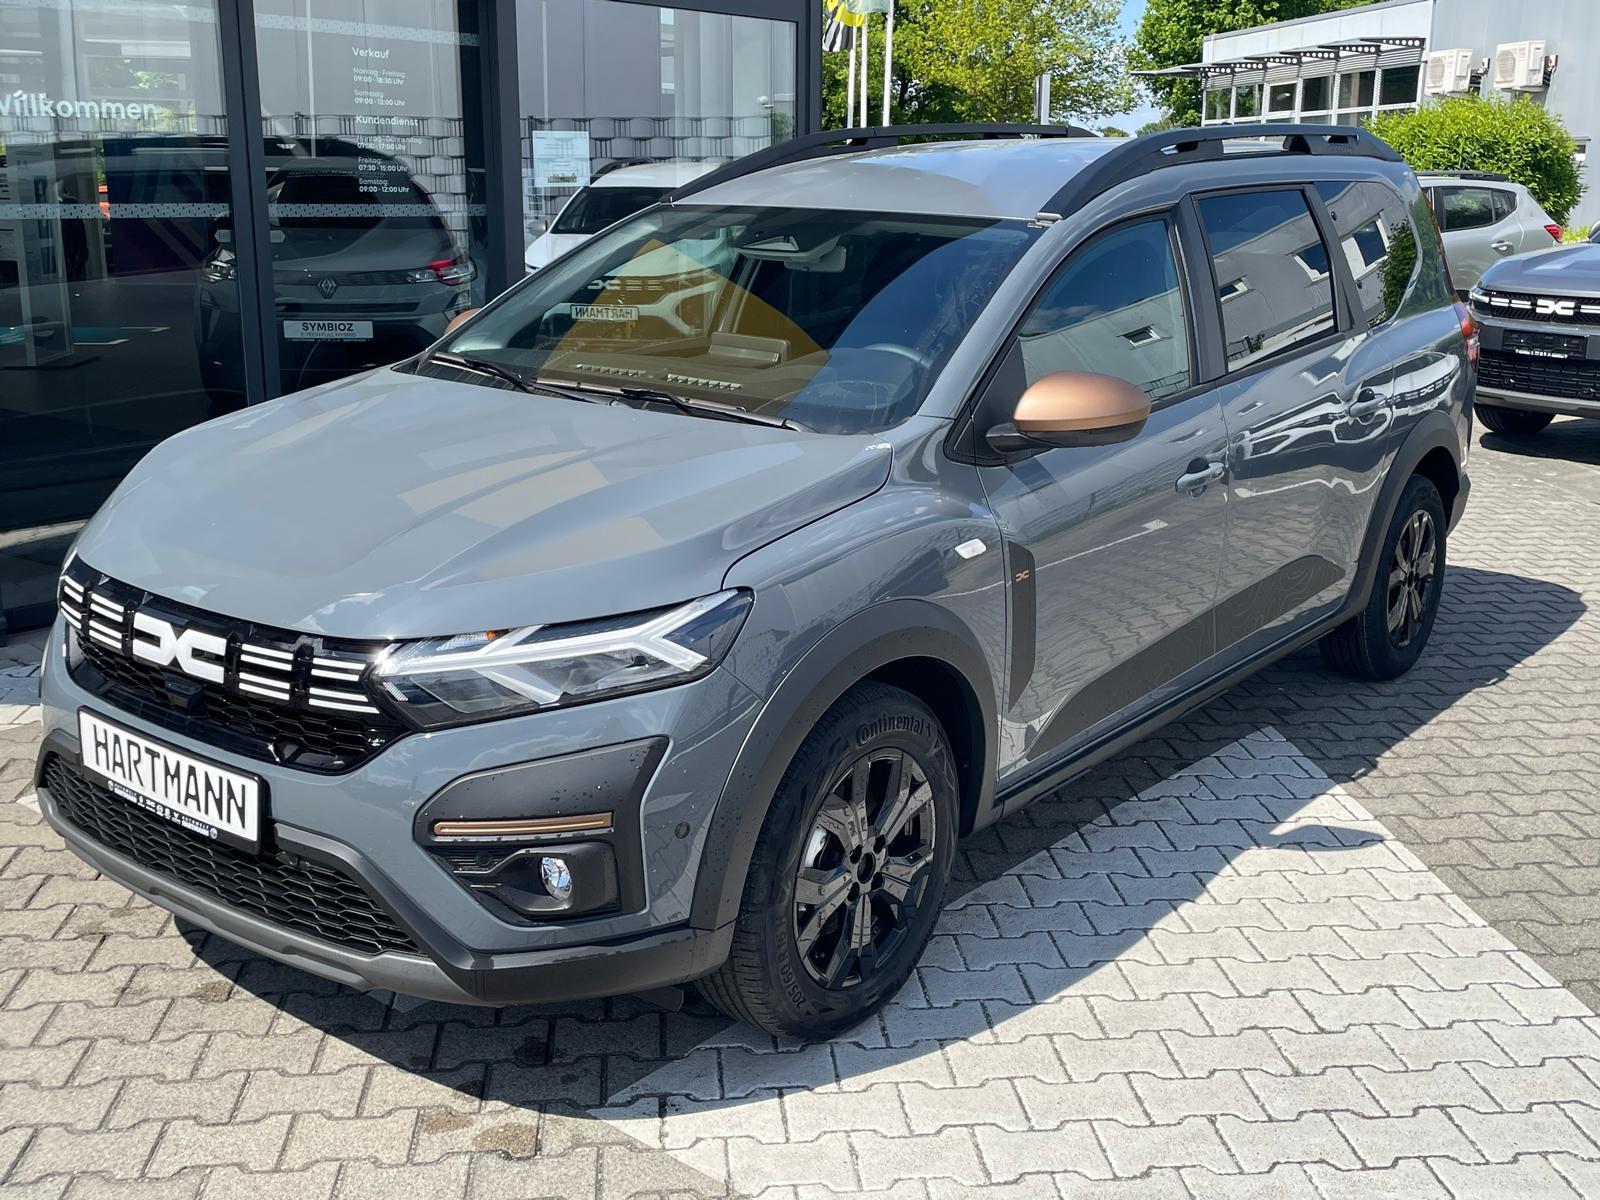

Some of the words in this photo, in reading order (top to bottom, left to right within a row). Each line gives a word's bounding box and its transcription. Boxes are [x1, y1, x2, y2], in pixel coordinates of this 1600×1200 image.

[352, 46, 390, 59] Verkauf
[356, 115, 418, 126] Kundendienst
[358, 185, 378, 193] 09:00
[302, 321, 354, 332] SYMBIOZ
[856, 713, 924, 747] Continental
[93, 723, 246, 829] HARTMANN
[780, 963, 806, 1009] 205/60
